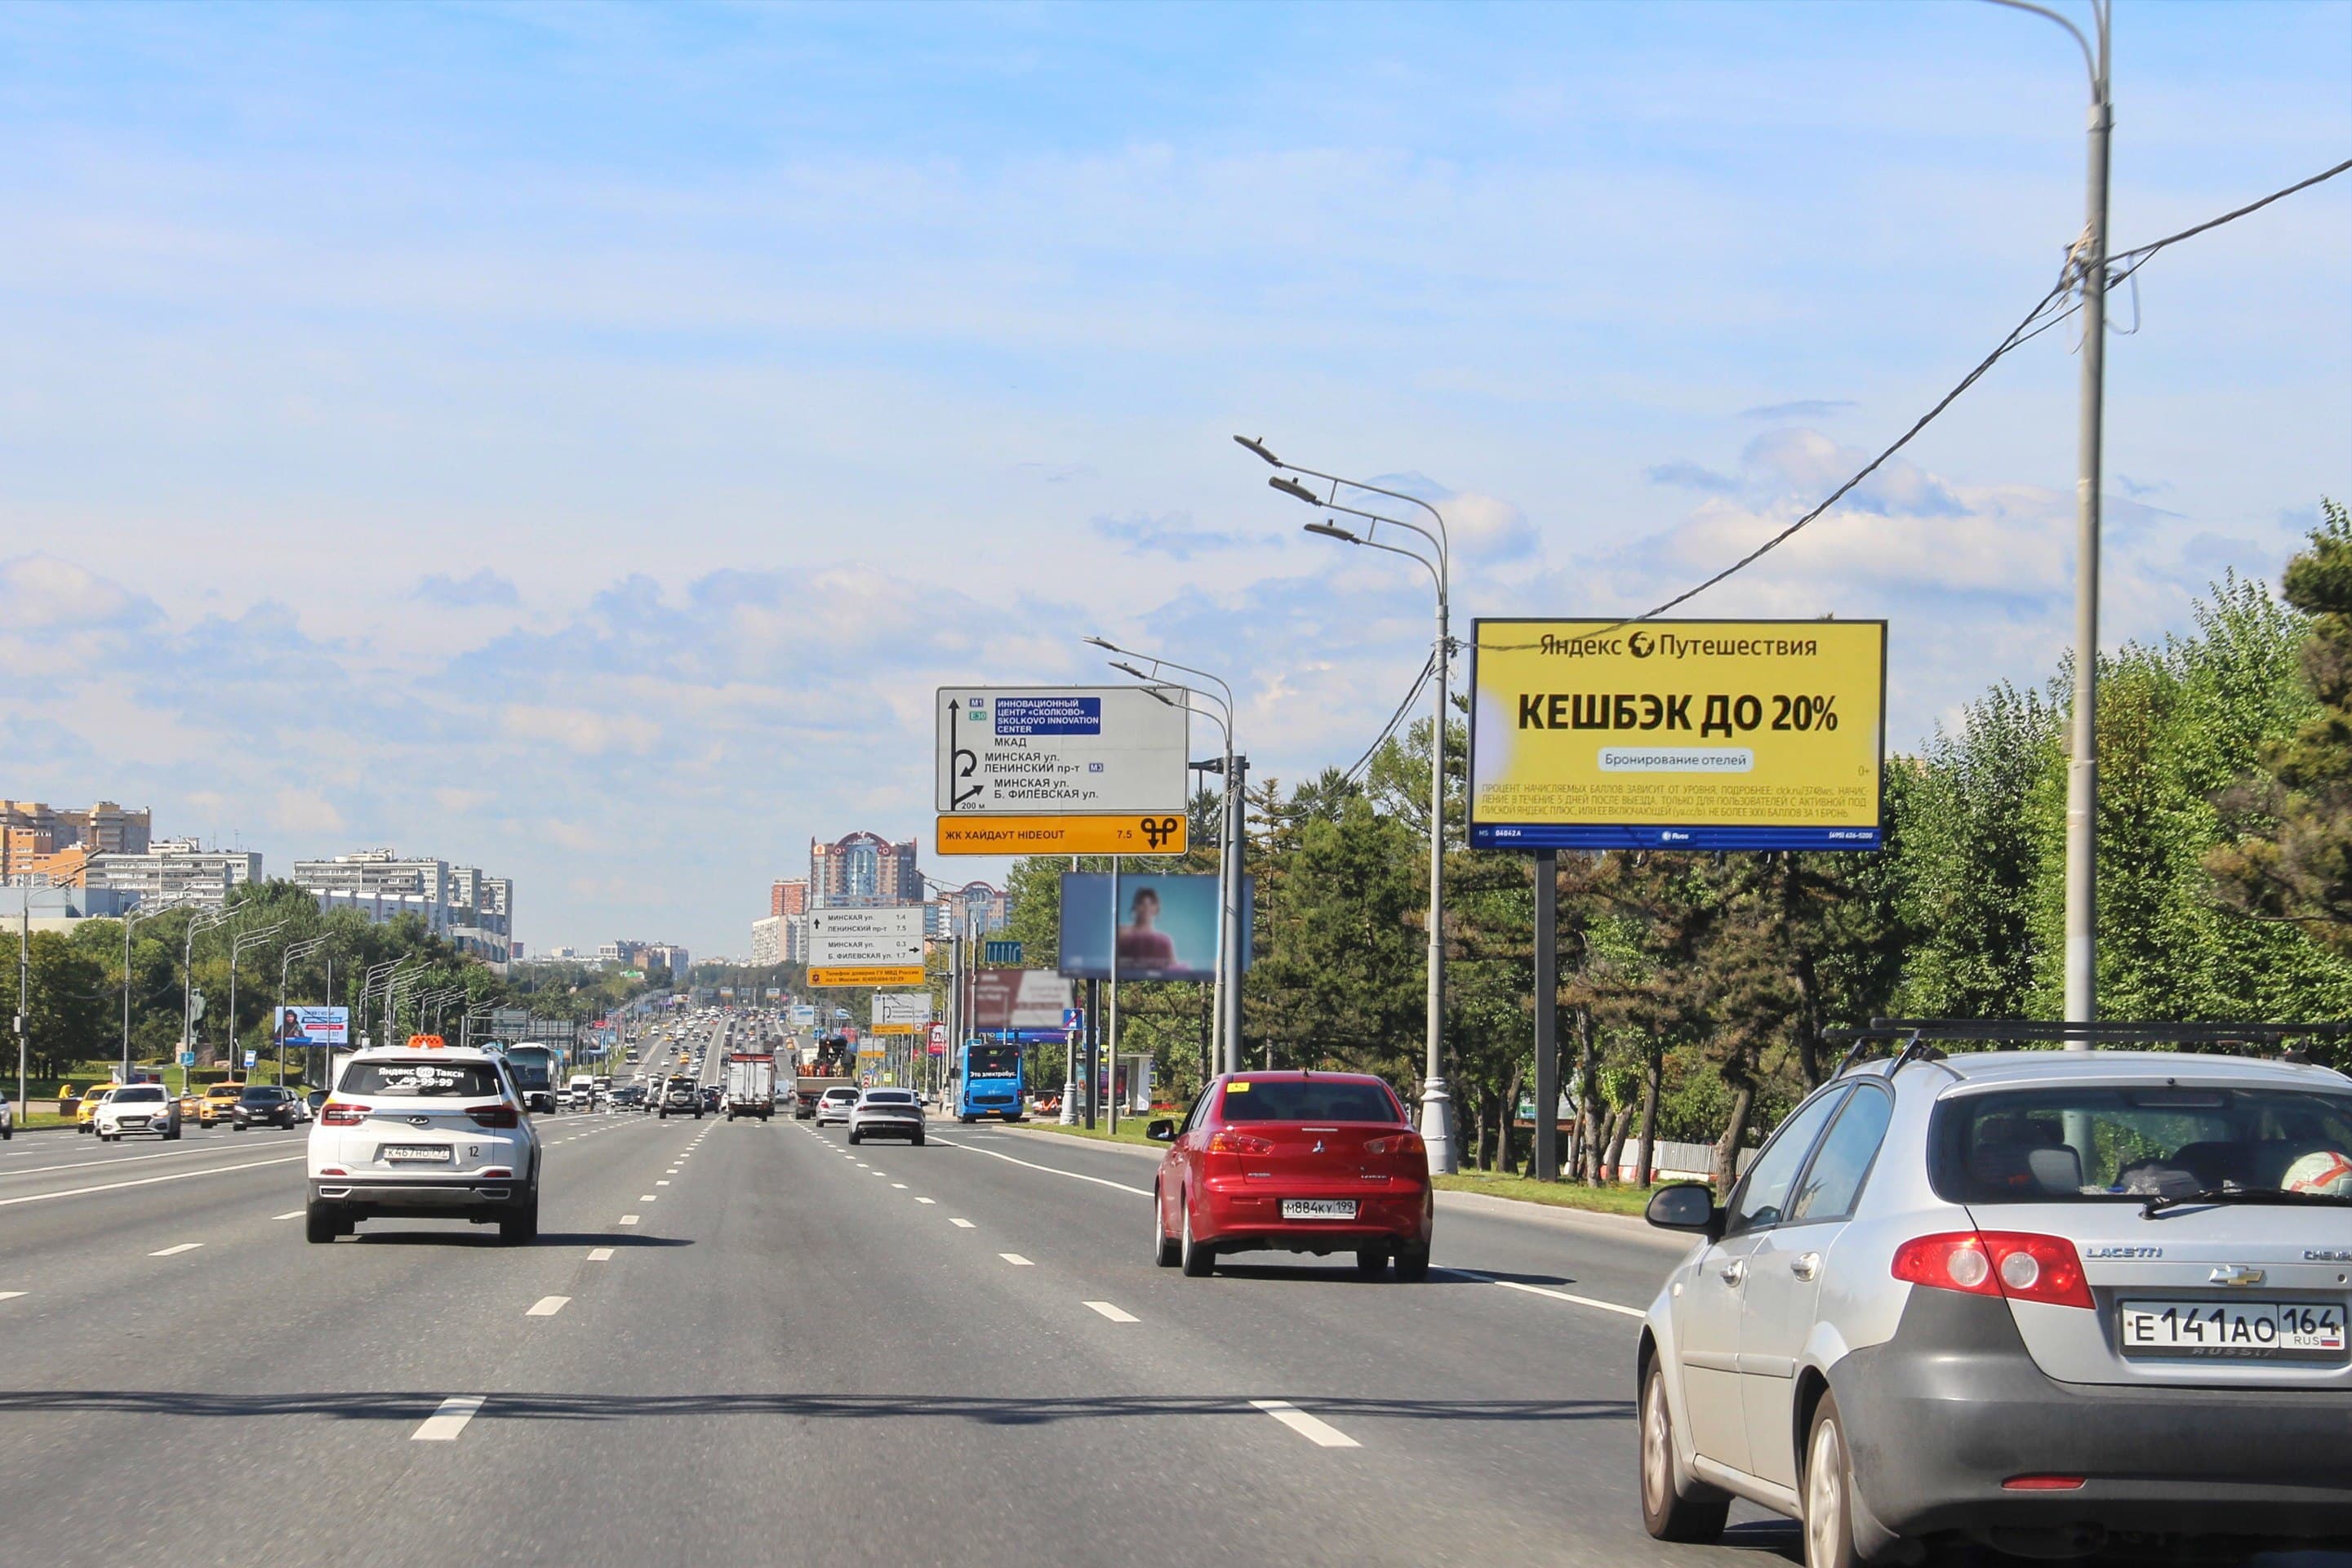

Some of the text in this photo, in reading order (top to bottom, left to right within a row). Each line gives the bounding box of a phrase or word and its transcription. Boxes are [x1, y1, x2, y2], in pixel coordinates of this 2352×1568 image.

[1541, 633, 1817, 660] Яндекс Путешествия
[998, 700, 1078, 708] ИННОВАЦИОННЫЙ
[998, 708, 1026, 717] ЦЕНТР
[1518, 694, 1838, 737] КЕШБЭК ДО 20%
[998, 717, 1099, 725] SKOLKOVO INNOVATION
[998, 726, 1033, 734] CENTER
[994, 738, 1027, 748] МКАД
[985, 753, 1060, 763] МИНСКАЯ ул.
[1605, 753, 1746, 768] Бронирование отелей
[984, 762, 1080, 774] ЛЕНИНСКИЙ пр-т
[1858, 766, 1870, 776] 0+
[994, 779, 1069, 789] МИНСКАЯ ул.
[1482, 784, 1520, 794] ПРОЦЕНТ
[1525, 784, 1586, 793] НАЧИСЛЯЕМЫХ
[1589, 784, 1623, 793] БАЛЛОВ
[1625, 784, 1664, 794] ЗАВИСИТ
[994, 790, 1005, 799] Б.
[1083, 791, 1098, 800] ул.
[945, 829, 1132, 841] ЖК ХАЙДАУТ HIDEOUT 7.5
[379, 1068, 415, 1077] Яндекс
[435, 1068, 465, 1078] Такси
[469, 1146, 479, 1157] 12
[2086, 1246, 2163, 1259] LACETTI
[2283, 1308, 2338, 1335] 164
[2294, 1335, 2319, 1346] RUS
